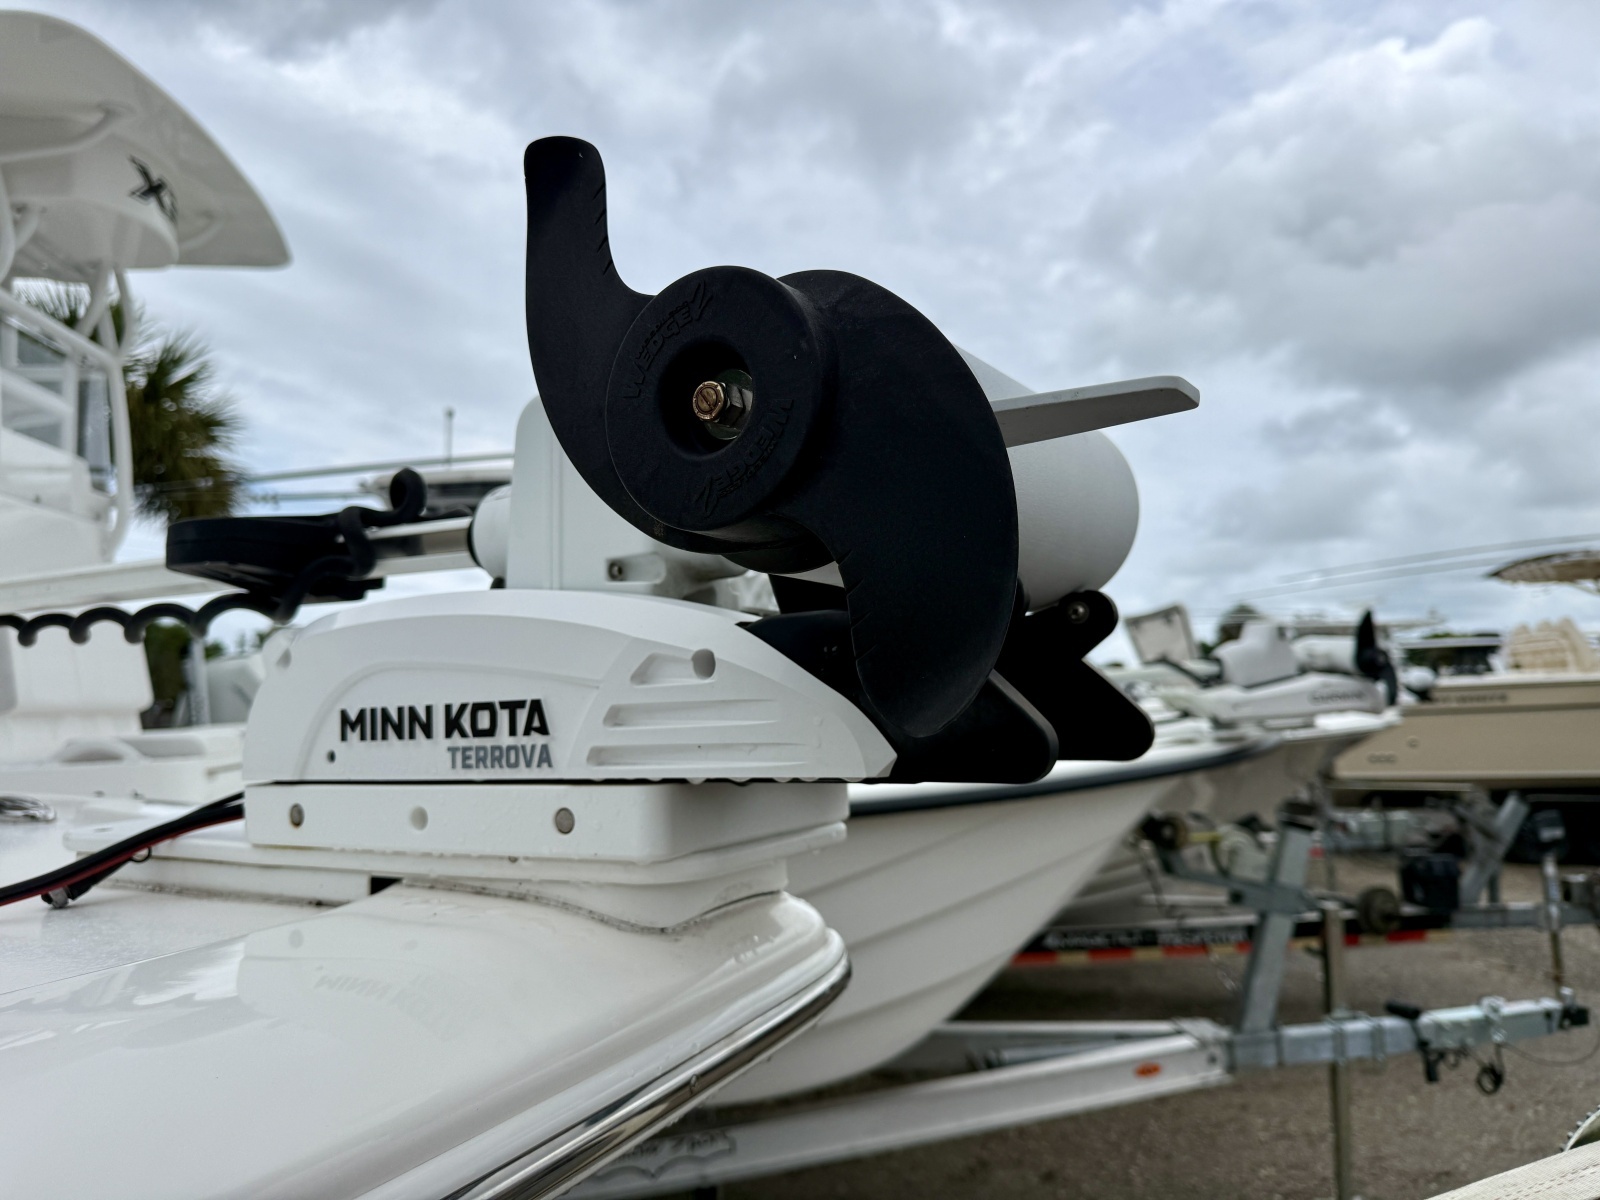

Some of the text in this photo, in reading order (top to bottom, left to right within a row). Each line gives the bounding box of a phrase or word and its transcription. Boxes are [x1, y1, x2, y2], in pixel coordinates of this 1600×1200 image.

[622, 304, 693, 399] WEDGE
[714, 399, 794, 493] WEDGE
[340, 698, 551, 742] MINN KOTA
[447, 743, 553, 770] TERROVA
